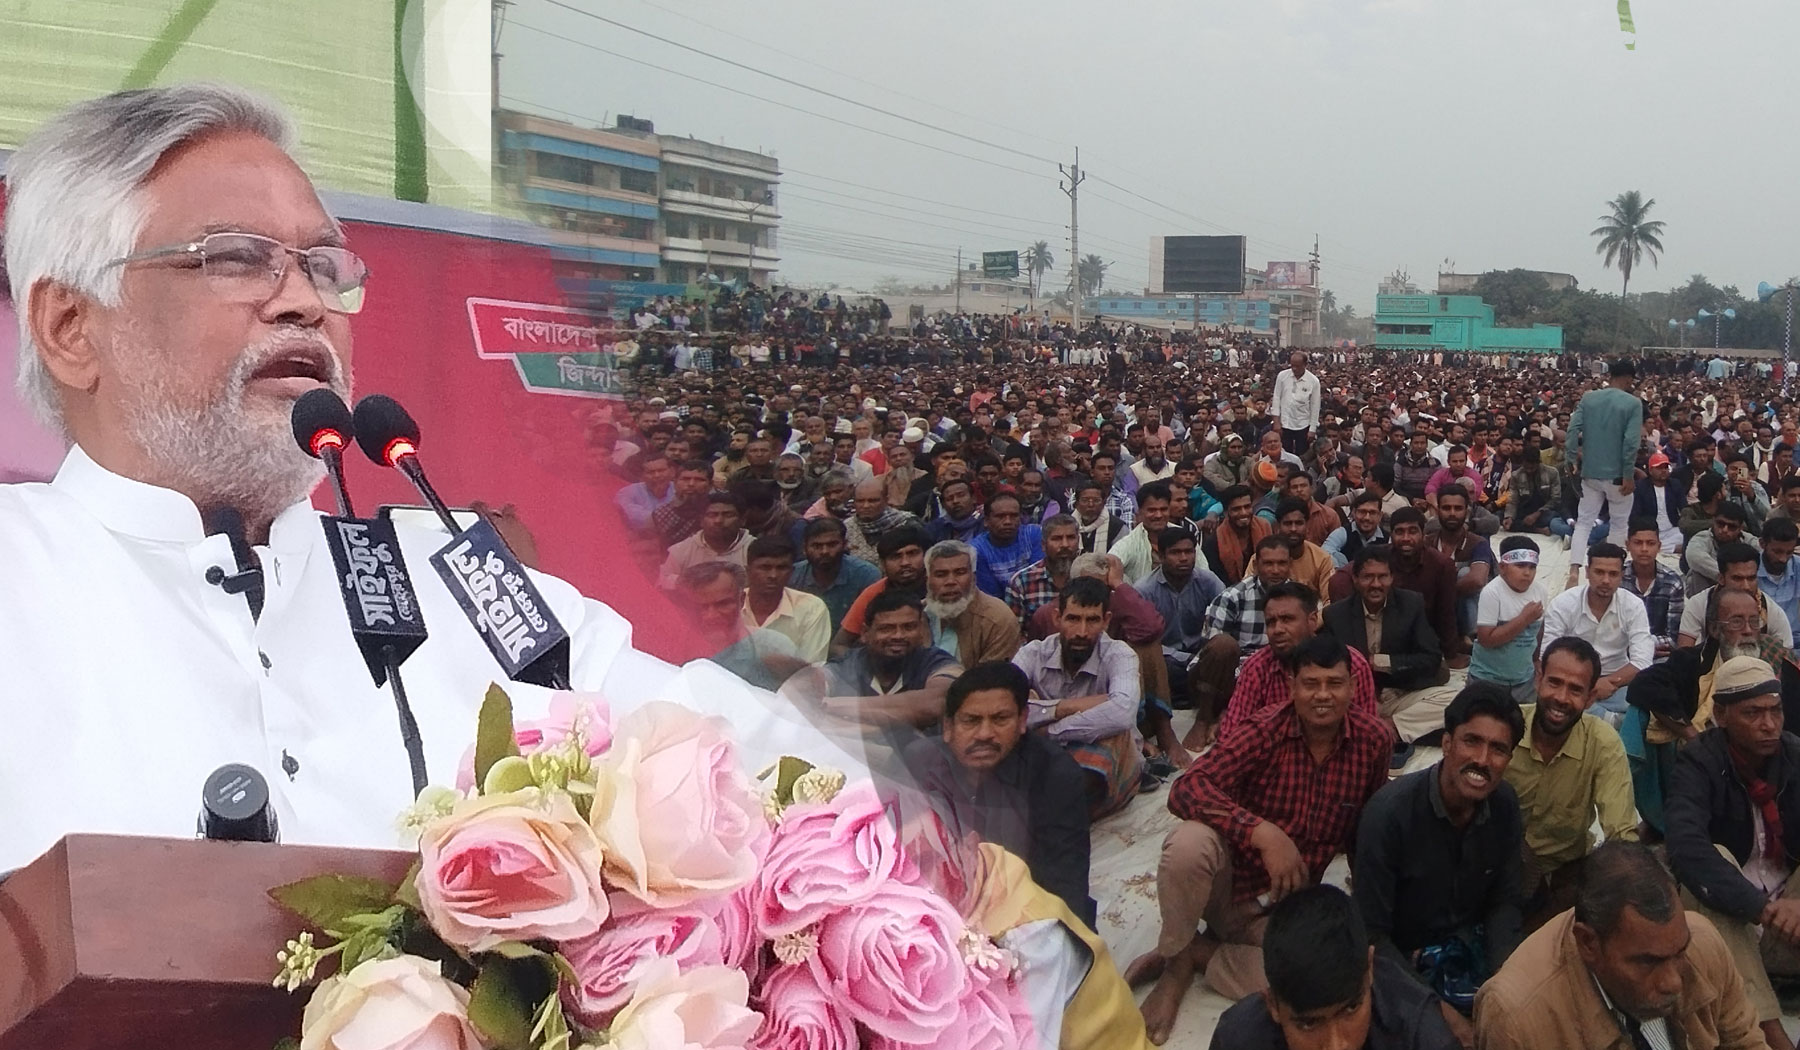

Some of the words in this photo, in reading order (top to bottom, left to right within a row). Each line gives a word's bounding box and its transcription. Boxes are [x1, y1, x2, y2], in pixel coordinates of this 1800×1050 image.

[501, 317, 598, 347] বাংলাদেশ
[336, 521, 395, 627] সাইফুল
[443, 539, 537, 664] সাইফুল
